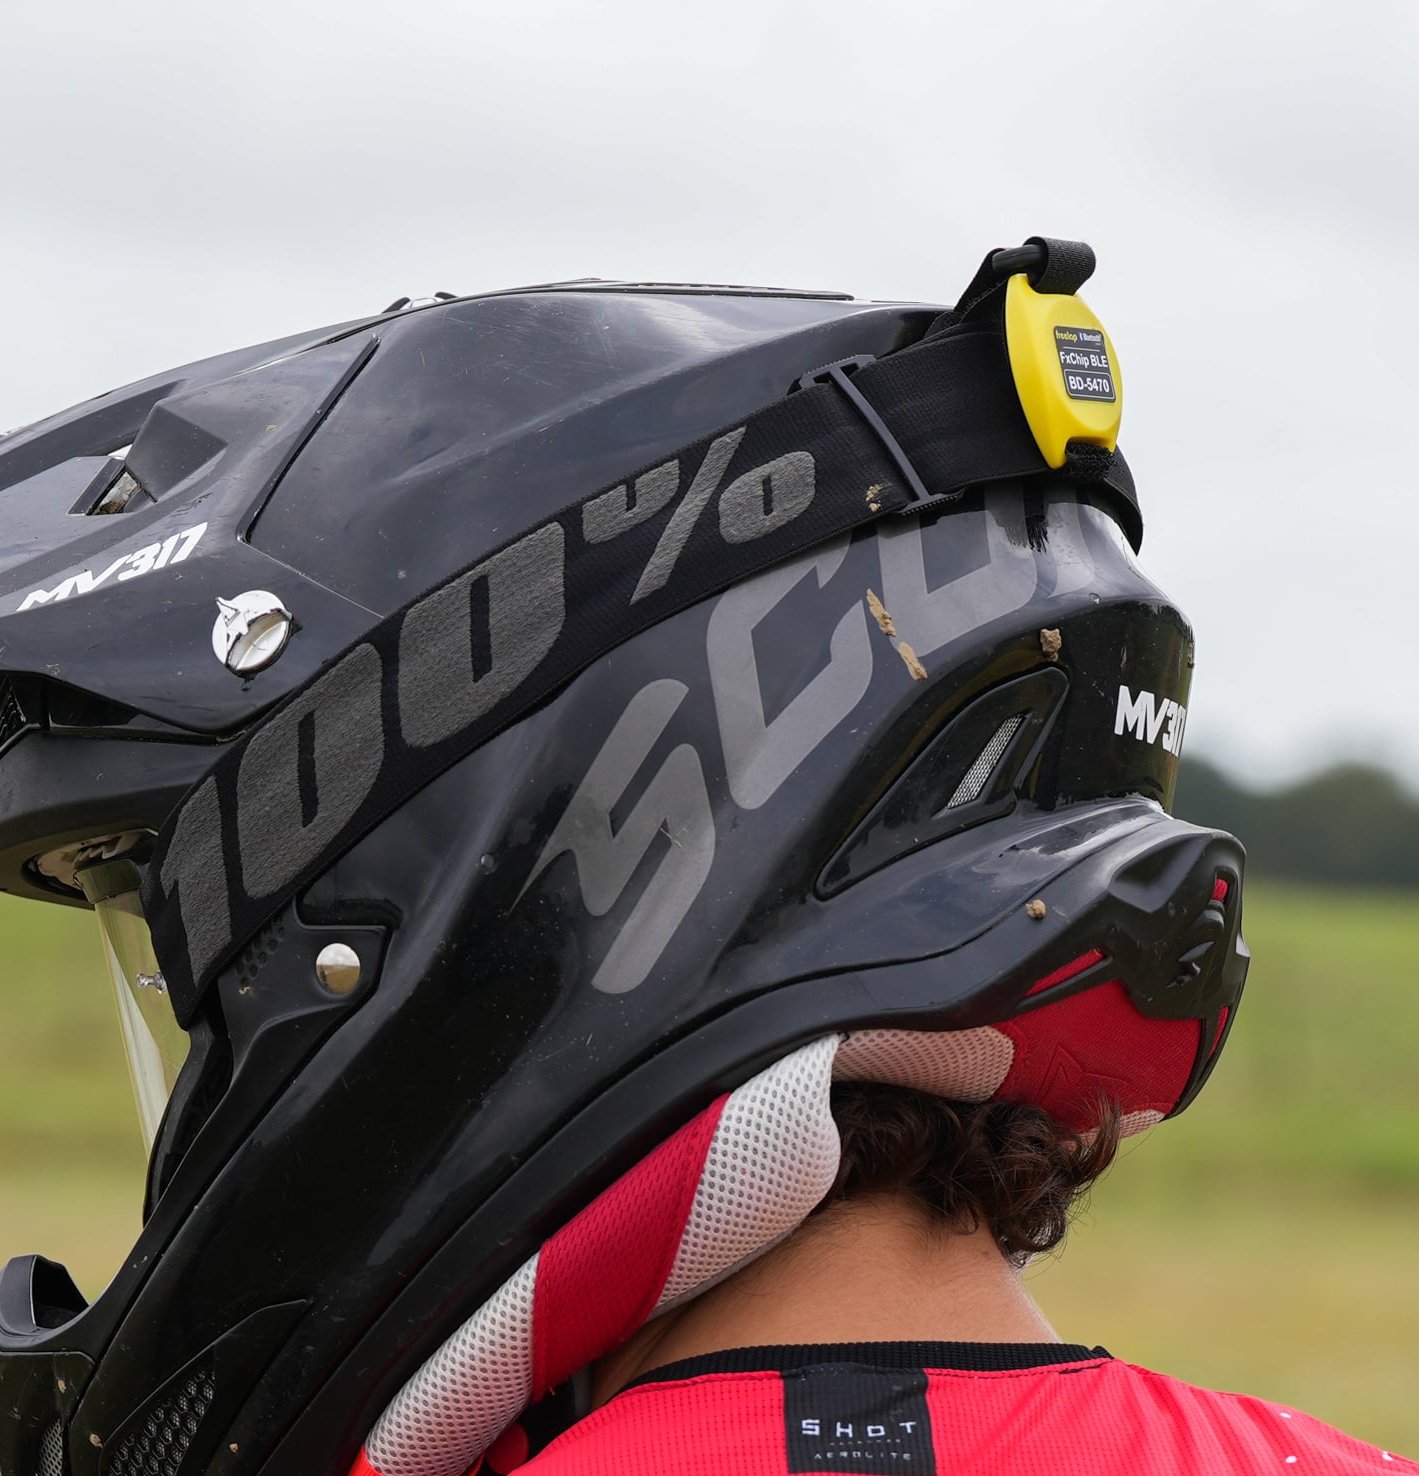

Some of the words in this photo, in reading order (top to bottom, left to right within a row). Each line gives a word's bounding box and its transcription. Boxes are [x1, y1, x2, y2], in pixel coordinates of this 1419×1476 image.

[1060, 352, 1089, 368] FxChip
[1090, 354, 1109, 368] BLE
[1068, 376, 1109, 392] BD-5470
[15, 521, 209, 613] MV317
[160, 426, 816, 986] 100%
[801, 1419, 918, 1438] SHOT
[813, 1450, 912, 1461] AEROLITE
